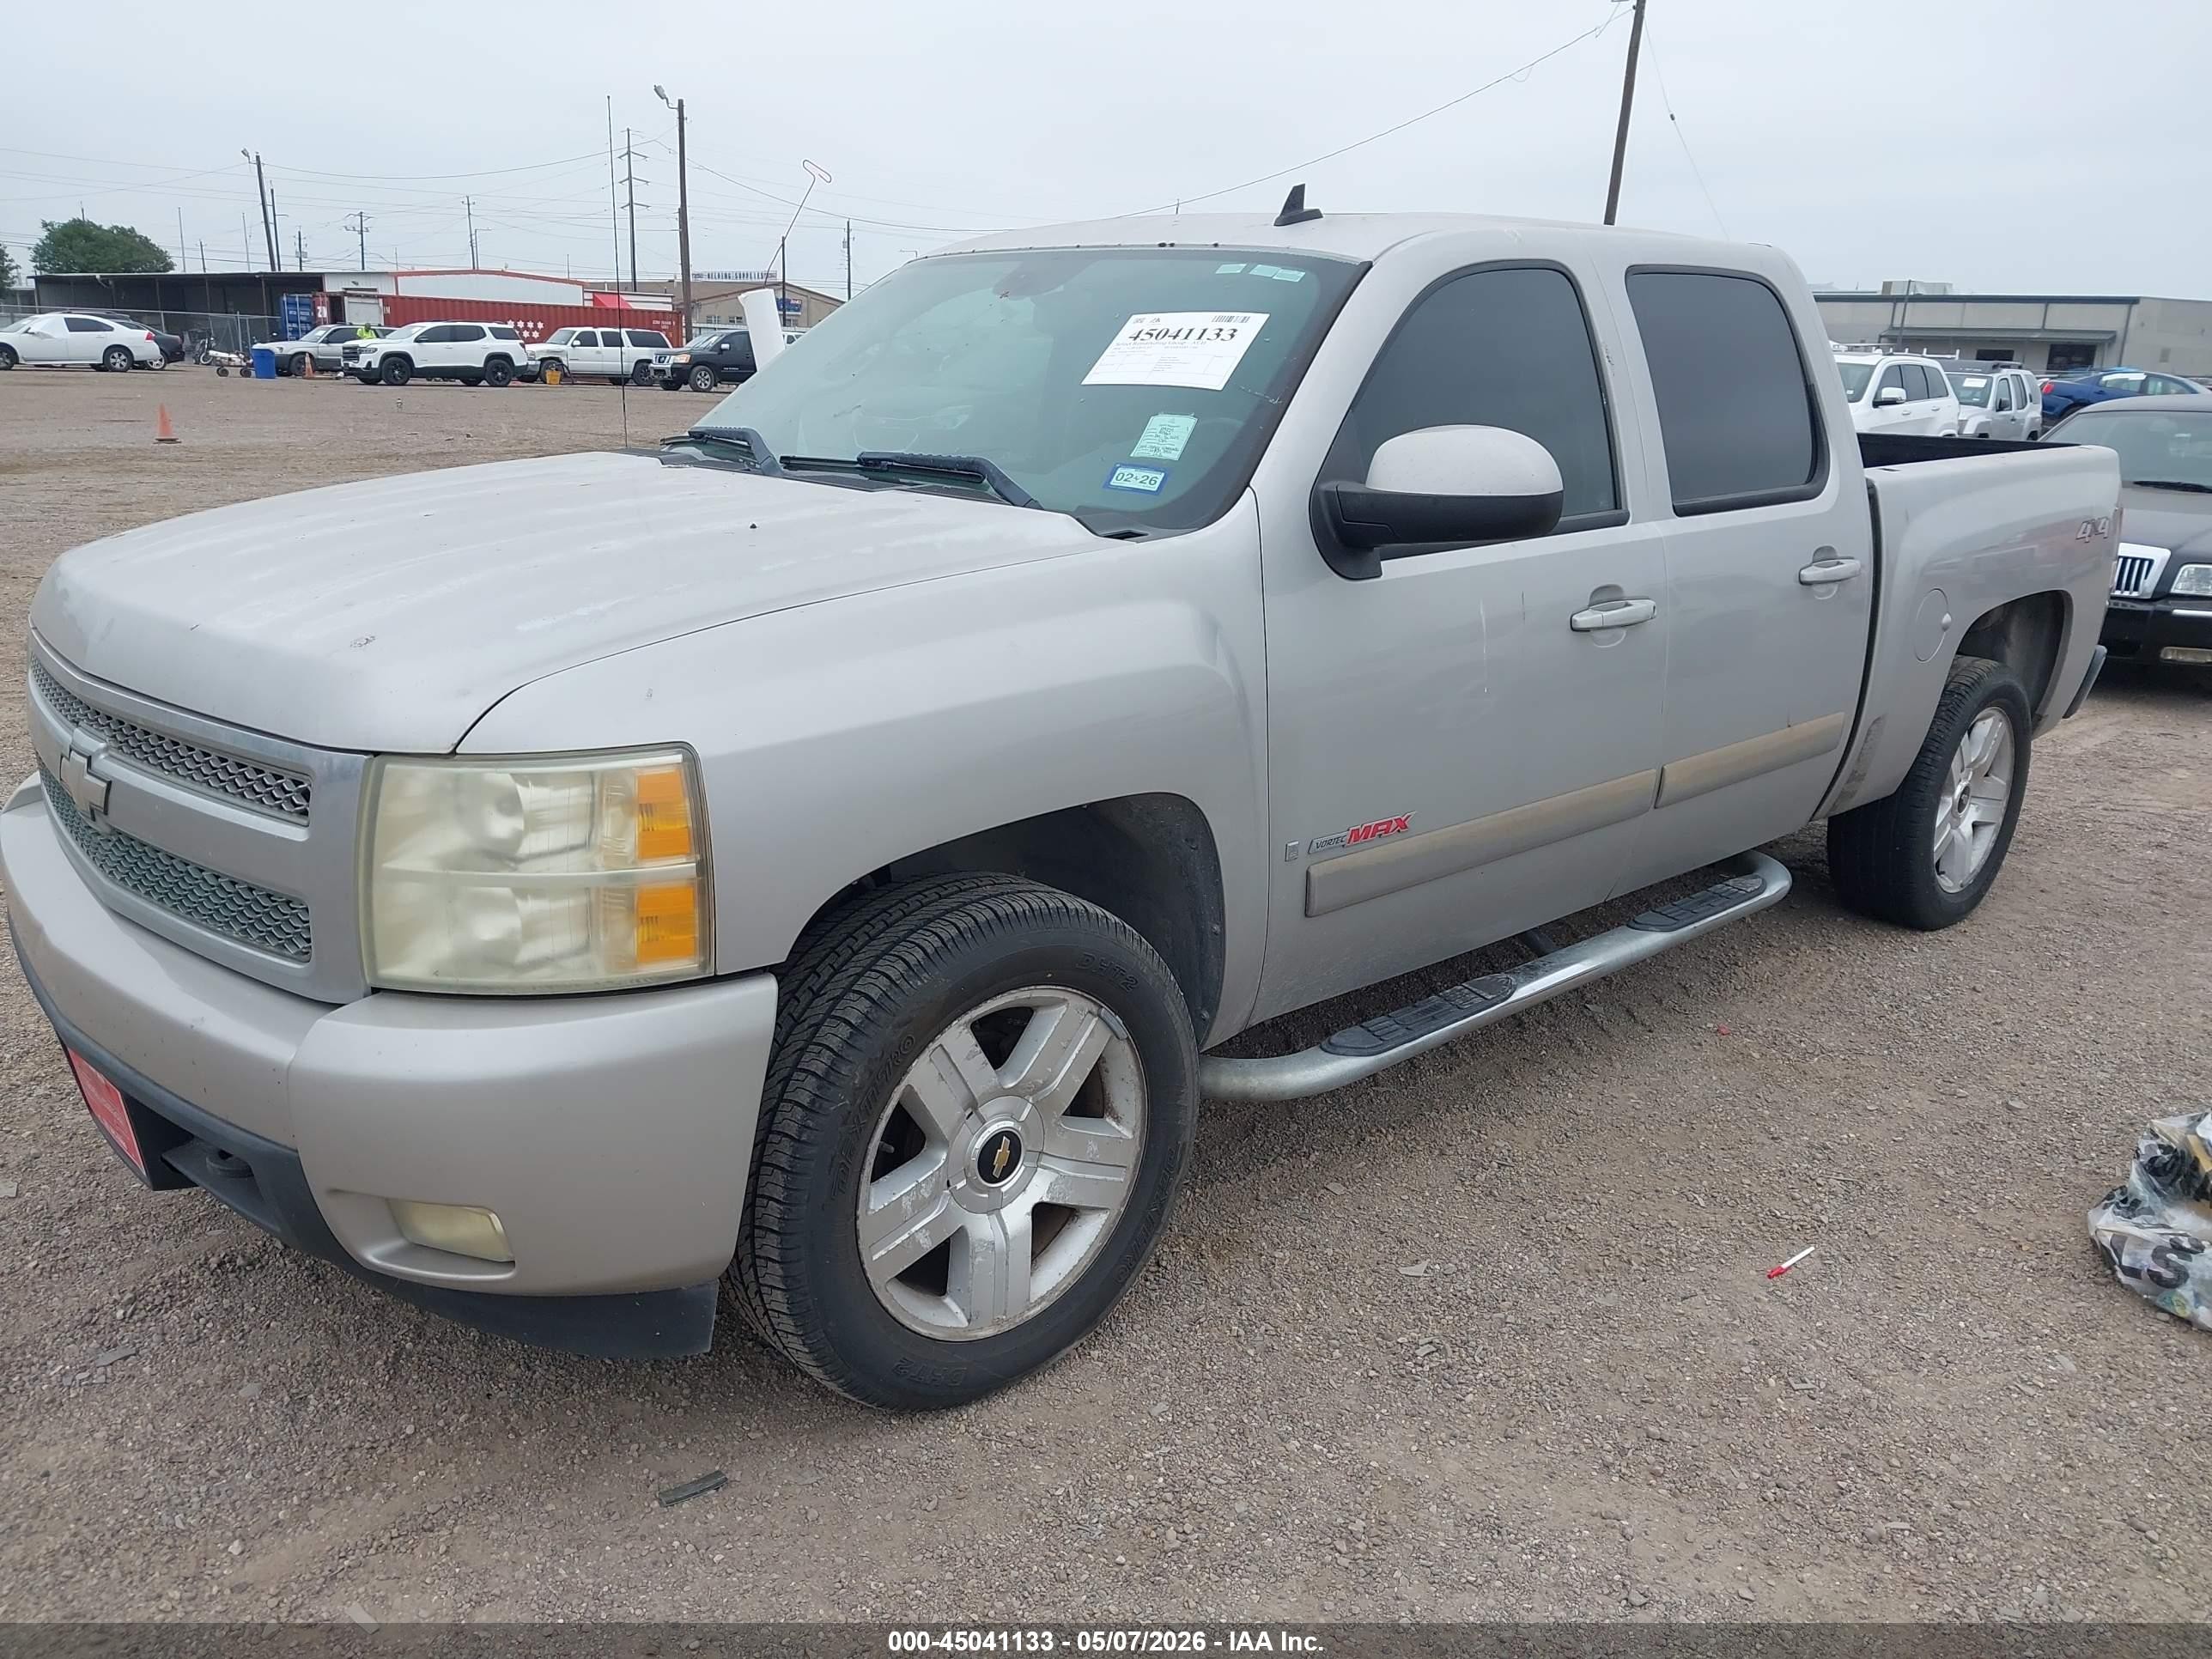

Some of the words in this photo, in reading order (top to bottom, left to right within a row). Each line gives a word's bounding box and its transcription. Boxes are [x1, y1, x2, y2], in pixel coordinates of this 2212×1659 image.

[1128, 326, 1238, 343] 45041133
[1316, 836, 1346, 849] VORTEC
[1346, 811, 1415, 845] MAX
